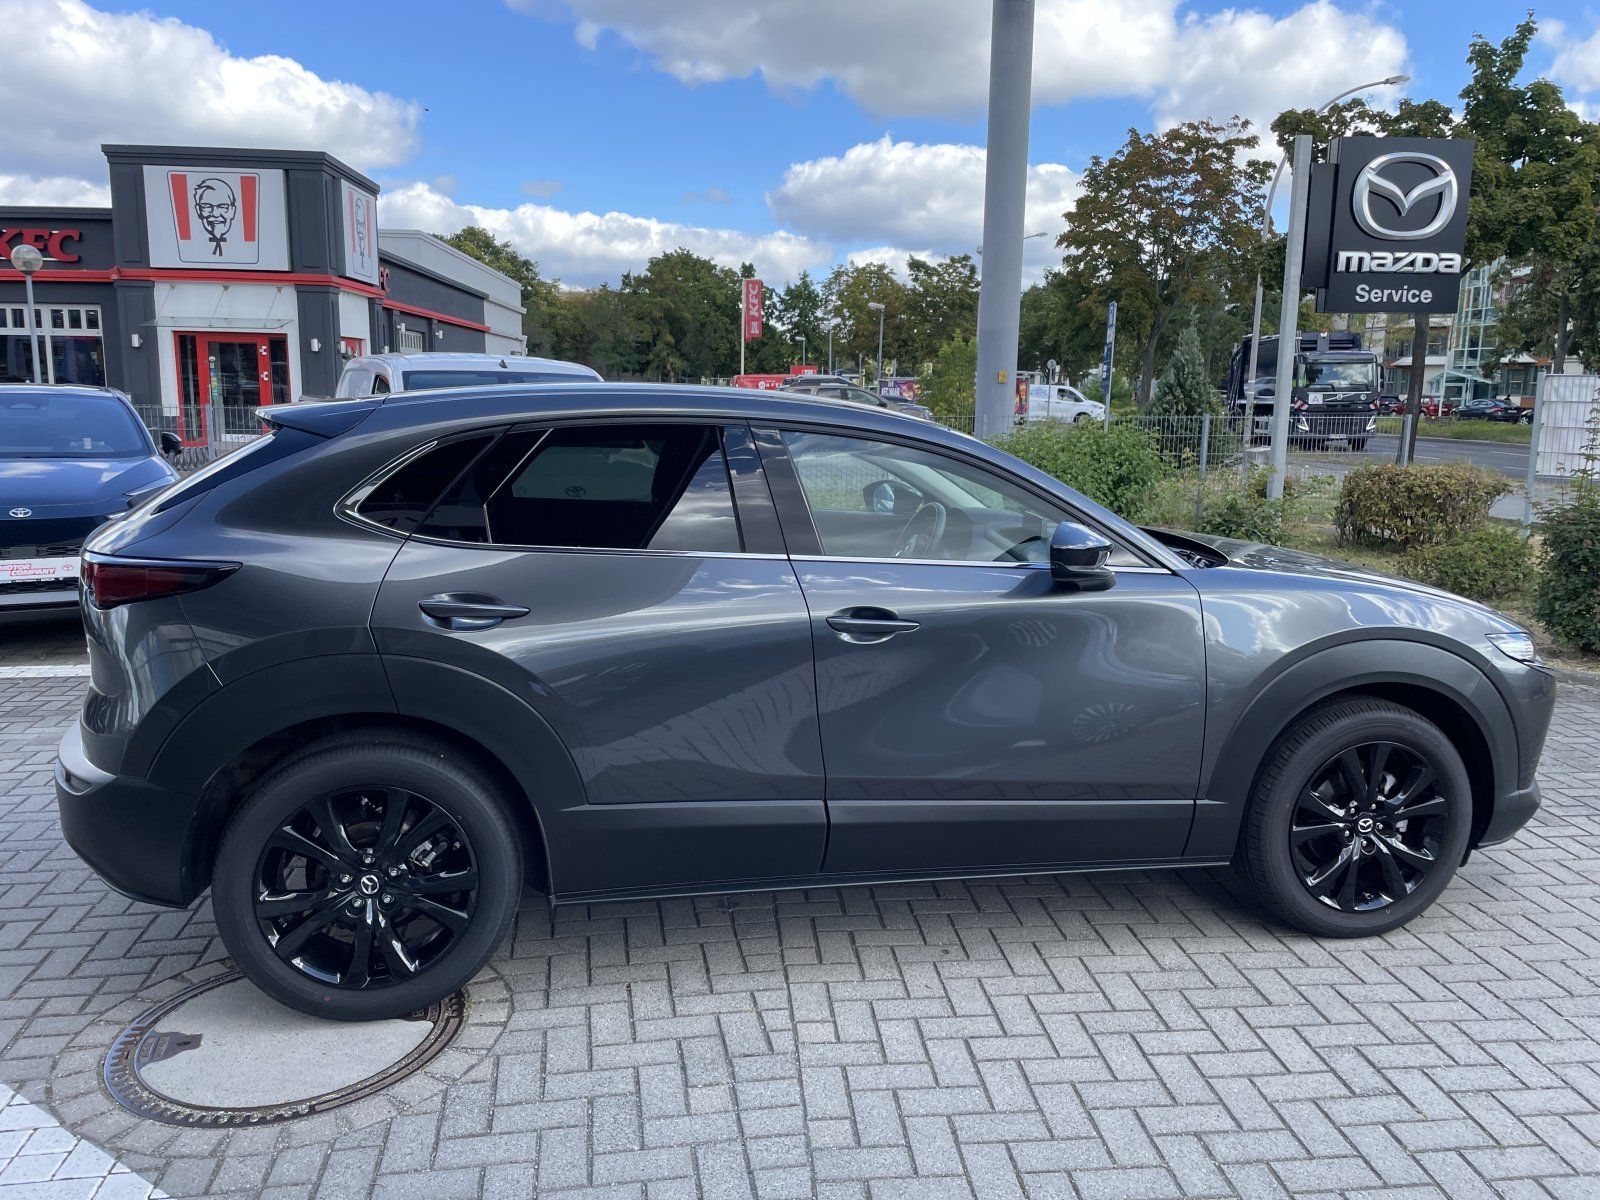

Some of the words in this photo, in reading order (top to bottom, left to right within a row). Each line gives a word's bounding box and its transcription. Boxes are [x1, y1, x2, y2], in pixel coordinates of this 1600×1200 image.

[749, 283, 759, 317] KFC
[1355, 284, 1433, 303] Service
[1311, 395, 1320, 403] A
[11, 568, 55, 576] COMPANY
